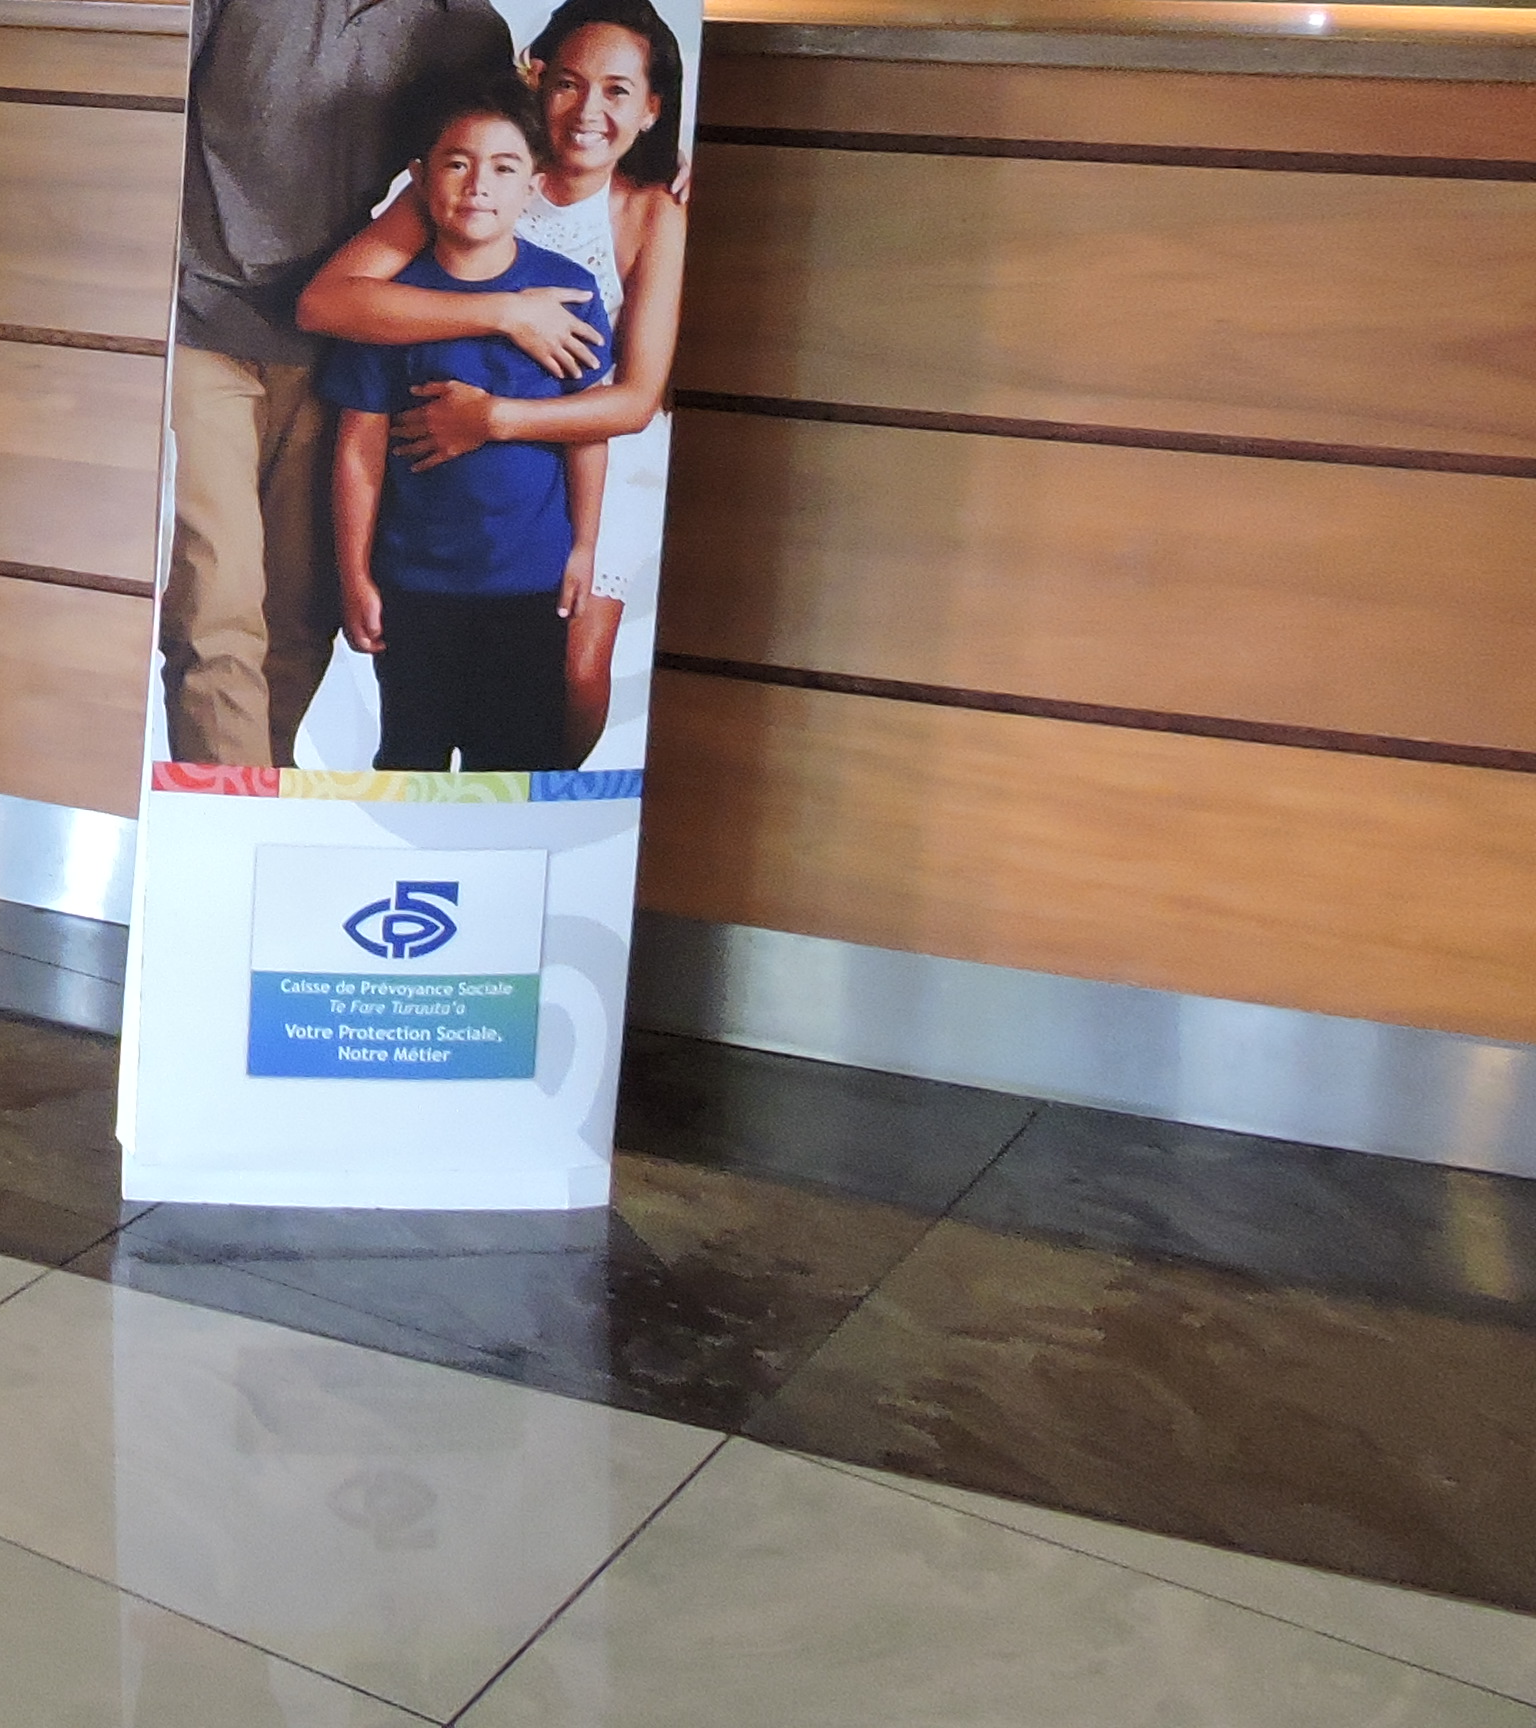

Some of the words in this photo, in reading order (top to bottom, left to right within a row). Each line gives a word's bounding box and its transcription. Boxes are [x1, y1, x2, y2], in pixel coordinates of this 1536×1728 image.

[280, 978, 330, 994] Caisse
[335, 980, 356, 995] de
[360, 981, 453, 999] Prévoyance
[458, 981, 513, 995] Sociale
[329, 999, 346, 1014] Te
[350, 1000, 385, 1014] Fare
[285, 1023, 333, 1039] Votre
[338, 1024, 431, 1041] Protection
[436, 1025, 503, 1042] Sociale,
[338, 1046, 388, 1062] Notre
[393, 1046, 451, 1062] Métier
